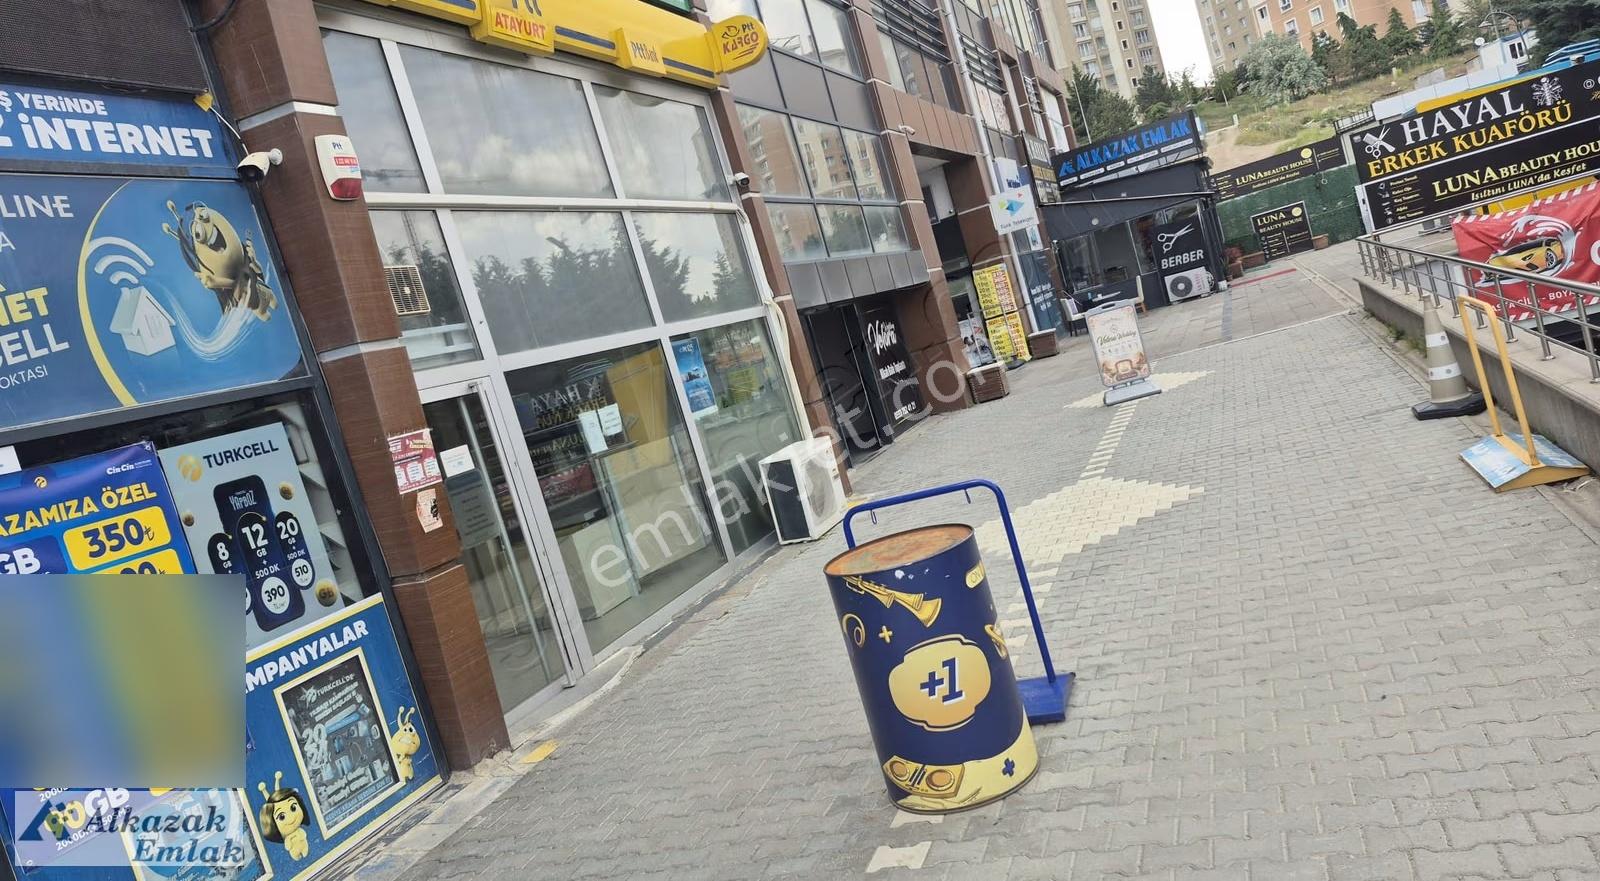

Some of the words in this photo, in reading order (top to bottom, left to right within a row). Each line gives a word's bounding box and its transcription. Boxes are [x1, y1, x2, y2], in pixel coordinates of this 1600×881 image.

[495, 12, 546, 40] ATAYURT
[741, 21, 755, 34] Ptt
[723, 32, 759, 54] KARGO
[14, 92, 108, 116] YERİNDE
[1400, 90, 1524, 146] HAYAL
[18, 113, 213, 158] İNTERNET
[1076, 134, 1140, 170] ALKAZAK
[1141, 118, 1190, 147] EMLAK
[1367, 141, 1447, 178] ERKEK
[1452, 100, 1571, 153] KUAFÖRÜ
[1235, 171, 1264, 186] LUNA
[1263, 165, 1289, 177] BEAUTY
[1289, 158, 1312, 169] HOUSE
[1432, 166, 1500, 197] LUNA
[1499, 152, 1561, 179] BEAUTY
[1257, 212, 1286, 226] LUNA
[1160, 249, 1204, 270] BERBER
[0, 322, 70, 368] ELL
[203, 439, 279, 468] TURKCELL
[106, 466, 120, 475] Cin
[121, 463, 134, 472] Cin
[101, 482, 157, 509] ÖZEL
[241, 523, 269, 550] 12
[276, 518, 298, 540] 20
[216, 542, 229, 561] 8
[256, 549, 268, 558] GB
[223, 561, 232, 569] GB
[255, 567, 270, 580] 500
[269, 563, 281, 575] DK
[294, 564, 309, 578] 510
[264, 585, 286, 603] 390
[246, 619, 369, 695] MPANYALAR
[919, 656, 965, 705] +1
